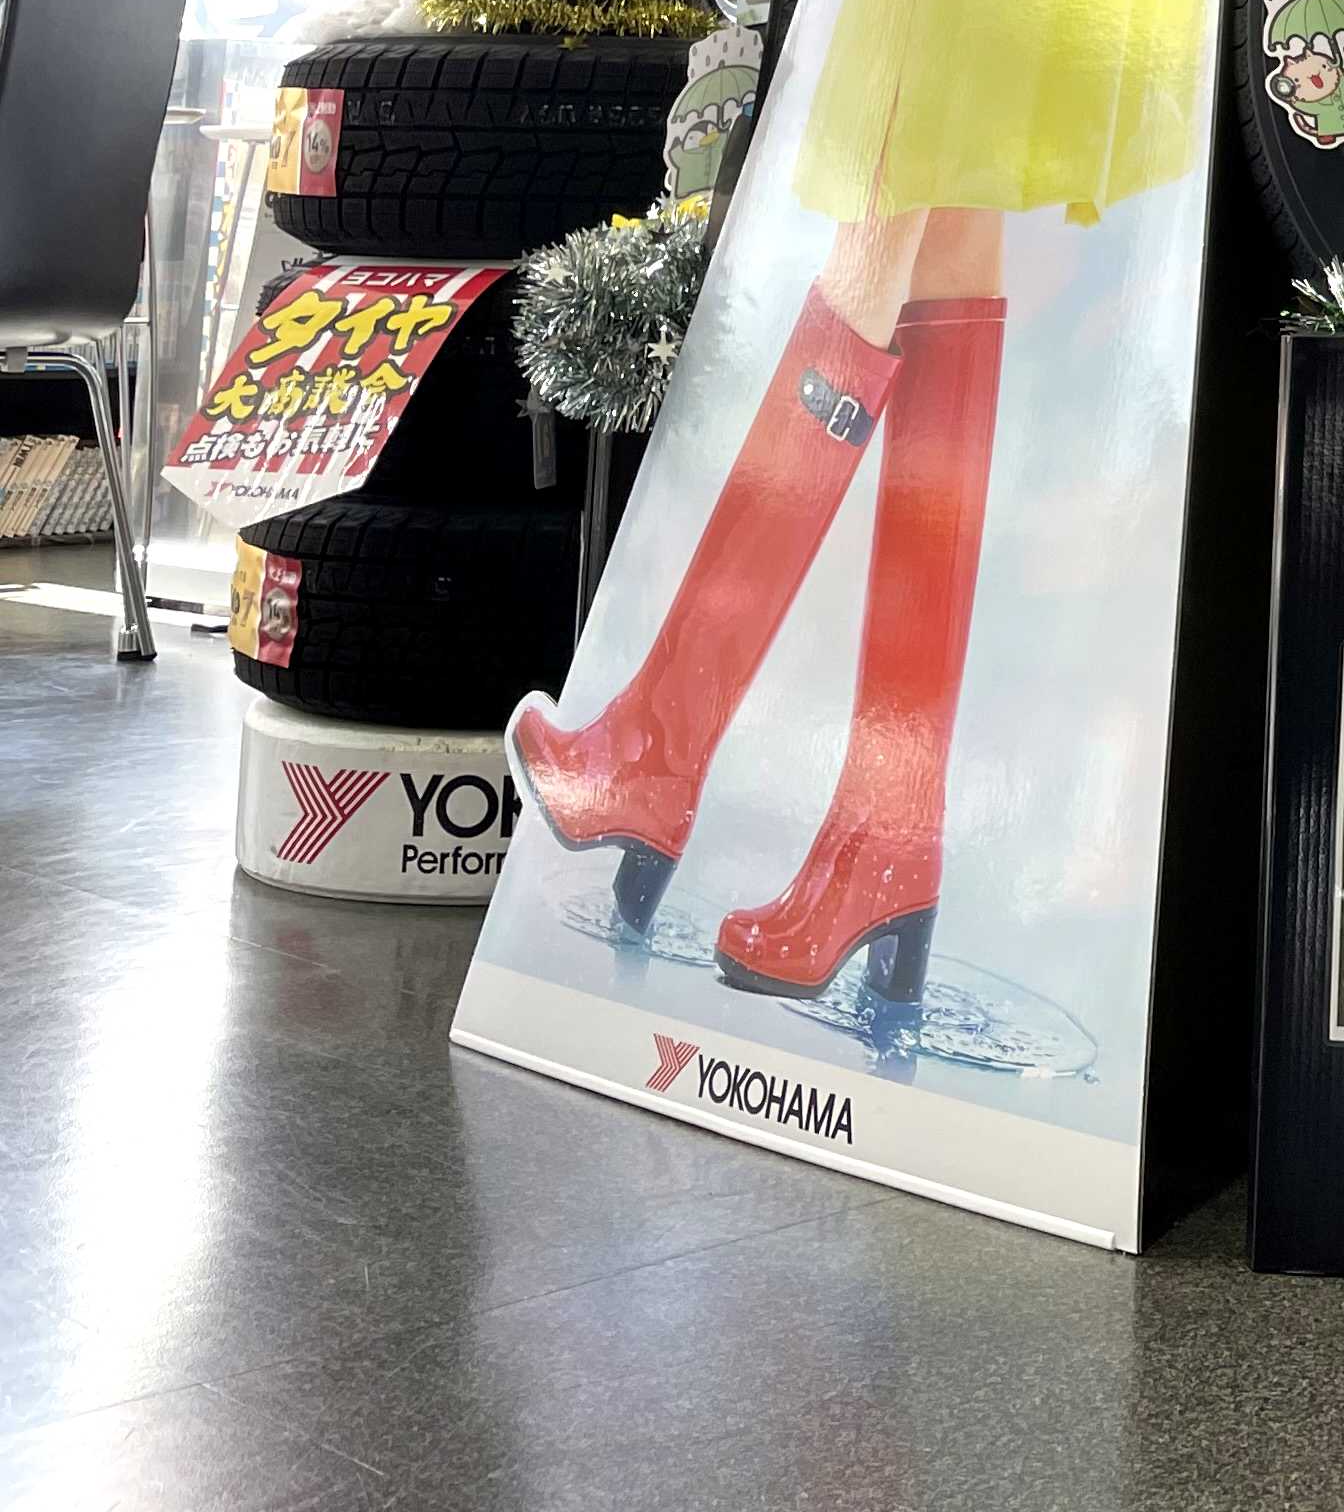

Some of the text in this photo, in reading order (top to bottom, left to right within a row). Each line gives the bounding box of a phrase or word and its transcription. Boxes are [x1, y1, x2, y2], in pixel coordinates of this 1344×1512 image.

[341, 271, 445, 288] ヨコハマ
[249, 291, 453, 365] タイヤ
[697, 1054, 854, 1145] YOKOHAMA
